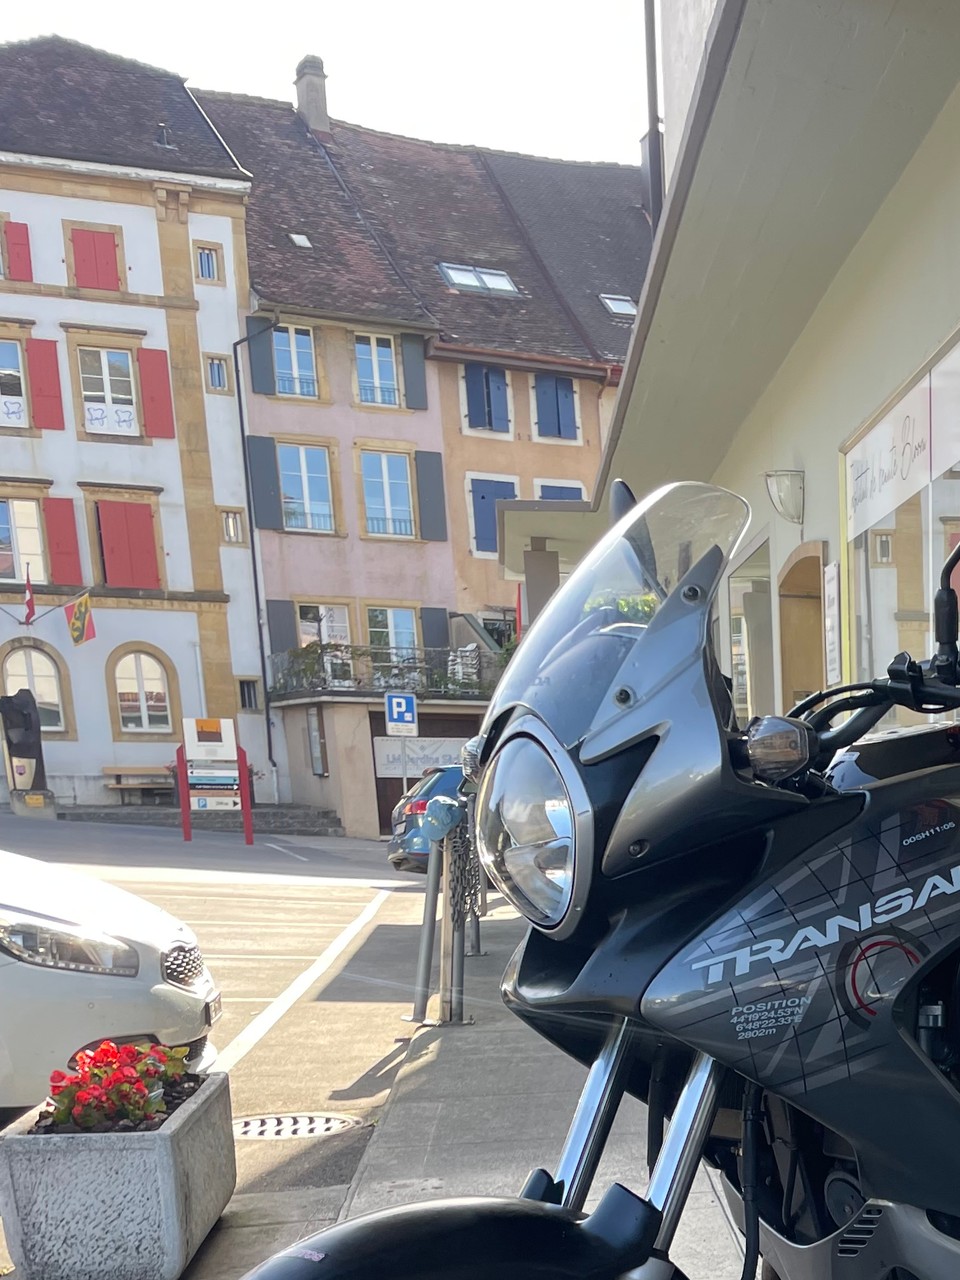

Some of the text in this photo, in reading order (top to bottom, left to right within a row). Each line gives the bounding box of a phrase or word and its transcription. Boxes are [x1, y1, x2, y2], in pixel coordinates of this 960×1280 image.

[392, 697, 407, 720] P
[731, 995, 812, 1015] POSITION
[737, 1028, 777, 1040] 2802m
